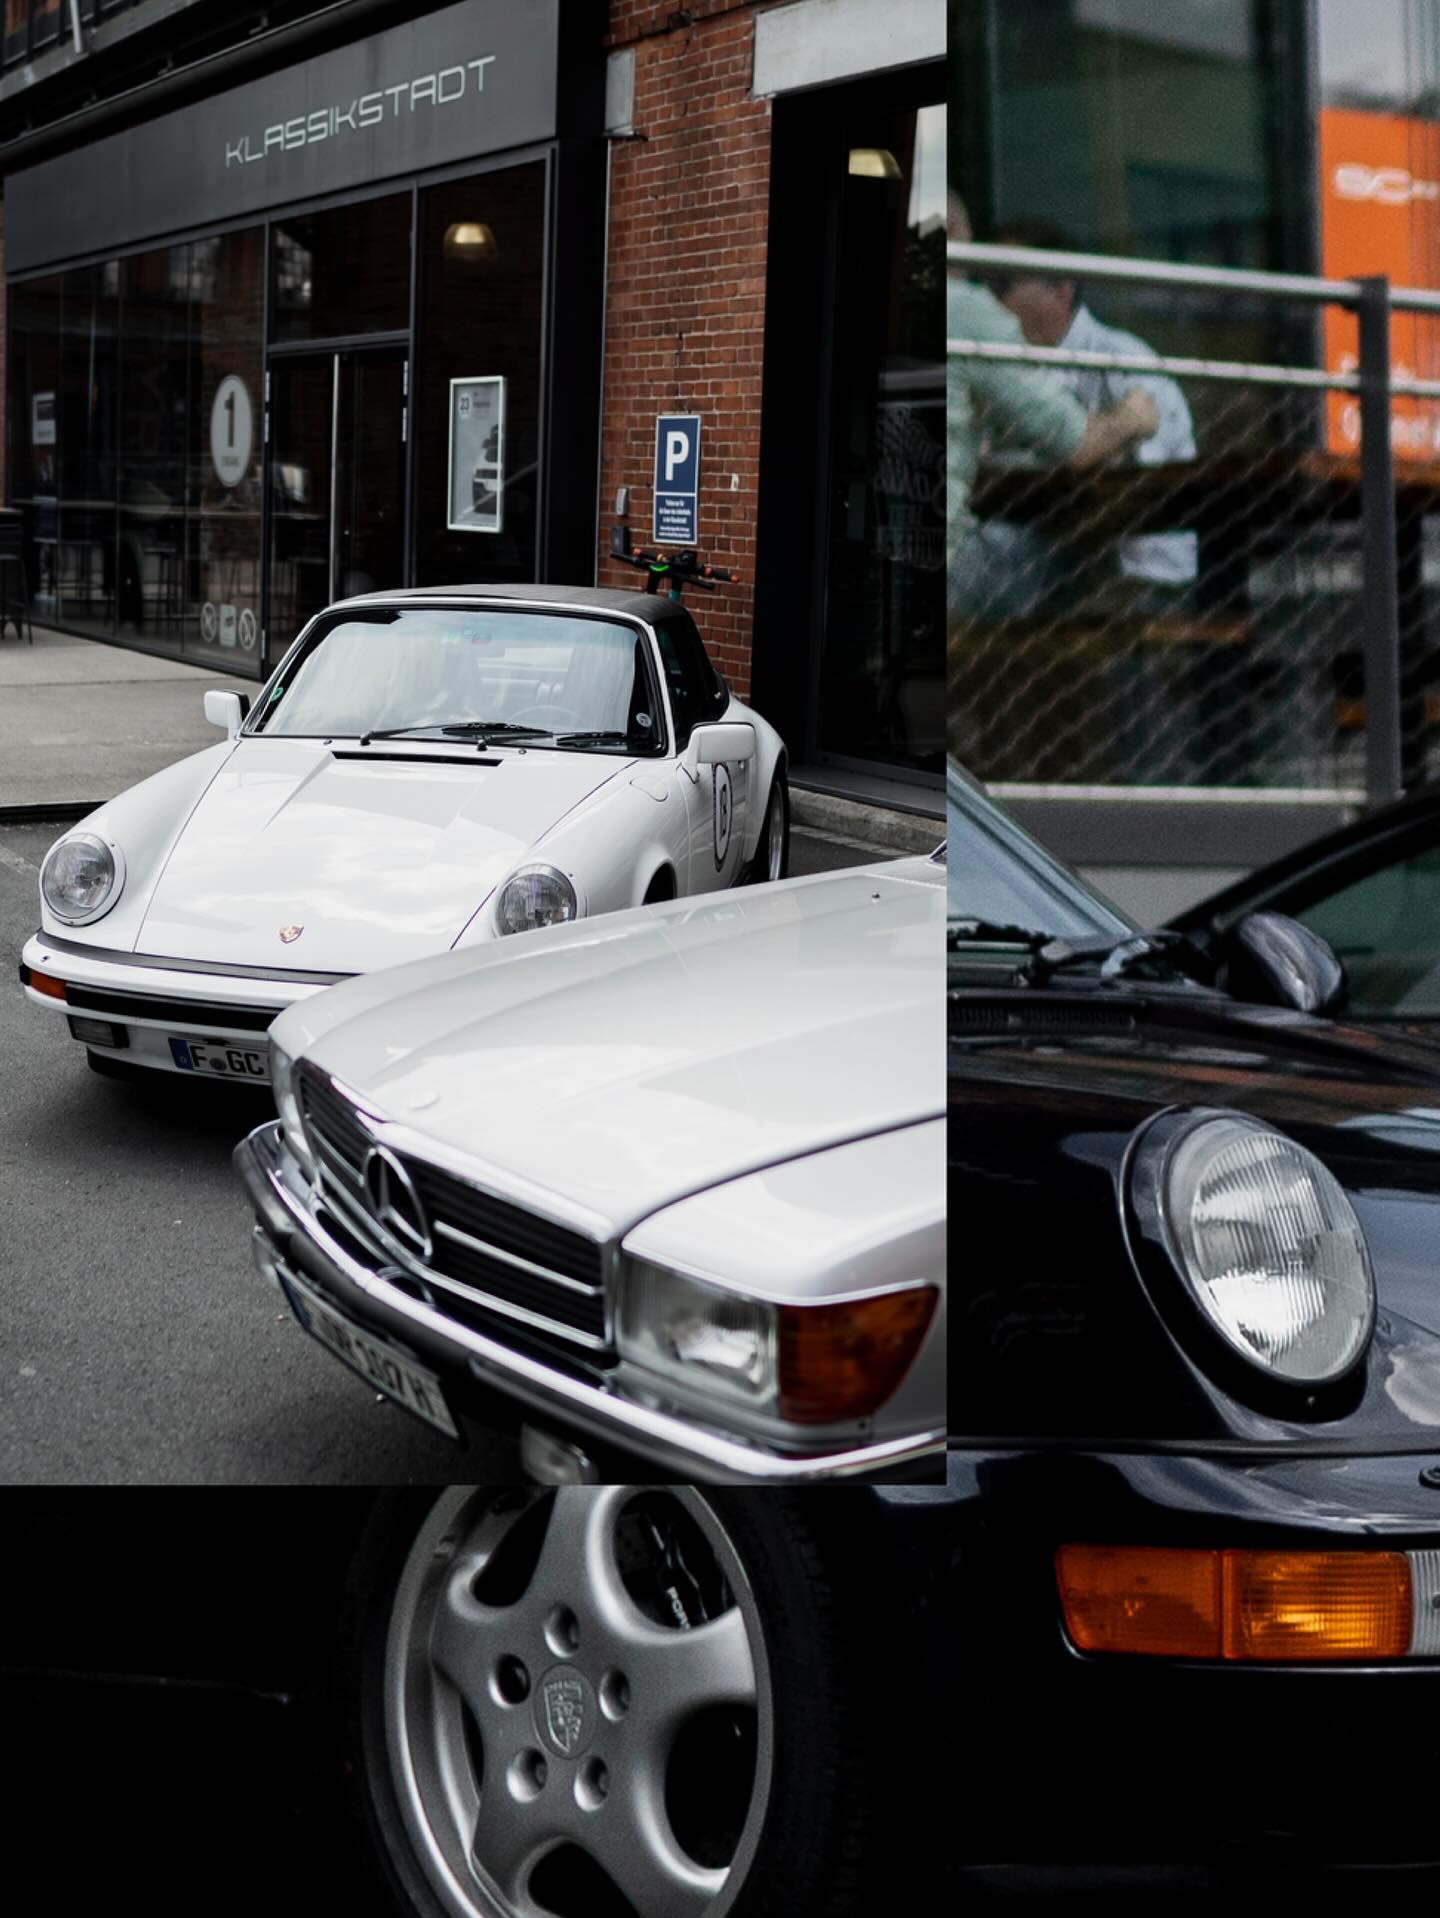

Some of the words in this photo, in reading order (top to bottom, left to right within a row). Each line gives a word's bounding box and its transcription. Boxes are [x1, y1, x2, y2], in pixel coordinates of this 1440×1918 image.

[226, 55, 496, 168] KLASSIKSTADT
[224, 391, 235, 448] 1
[665, 431, 689, 481] P
[190, 1044, 207, 1068] F
[225, 1049, 265, 1076] GC
